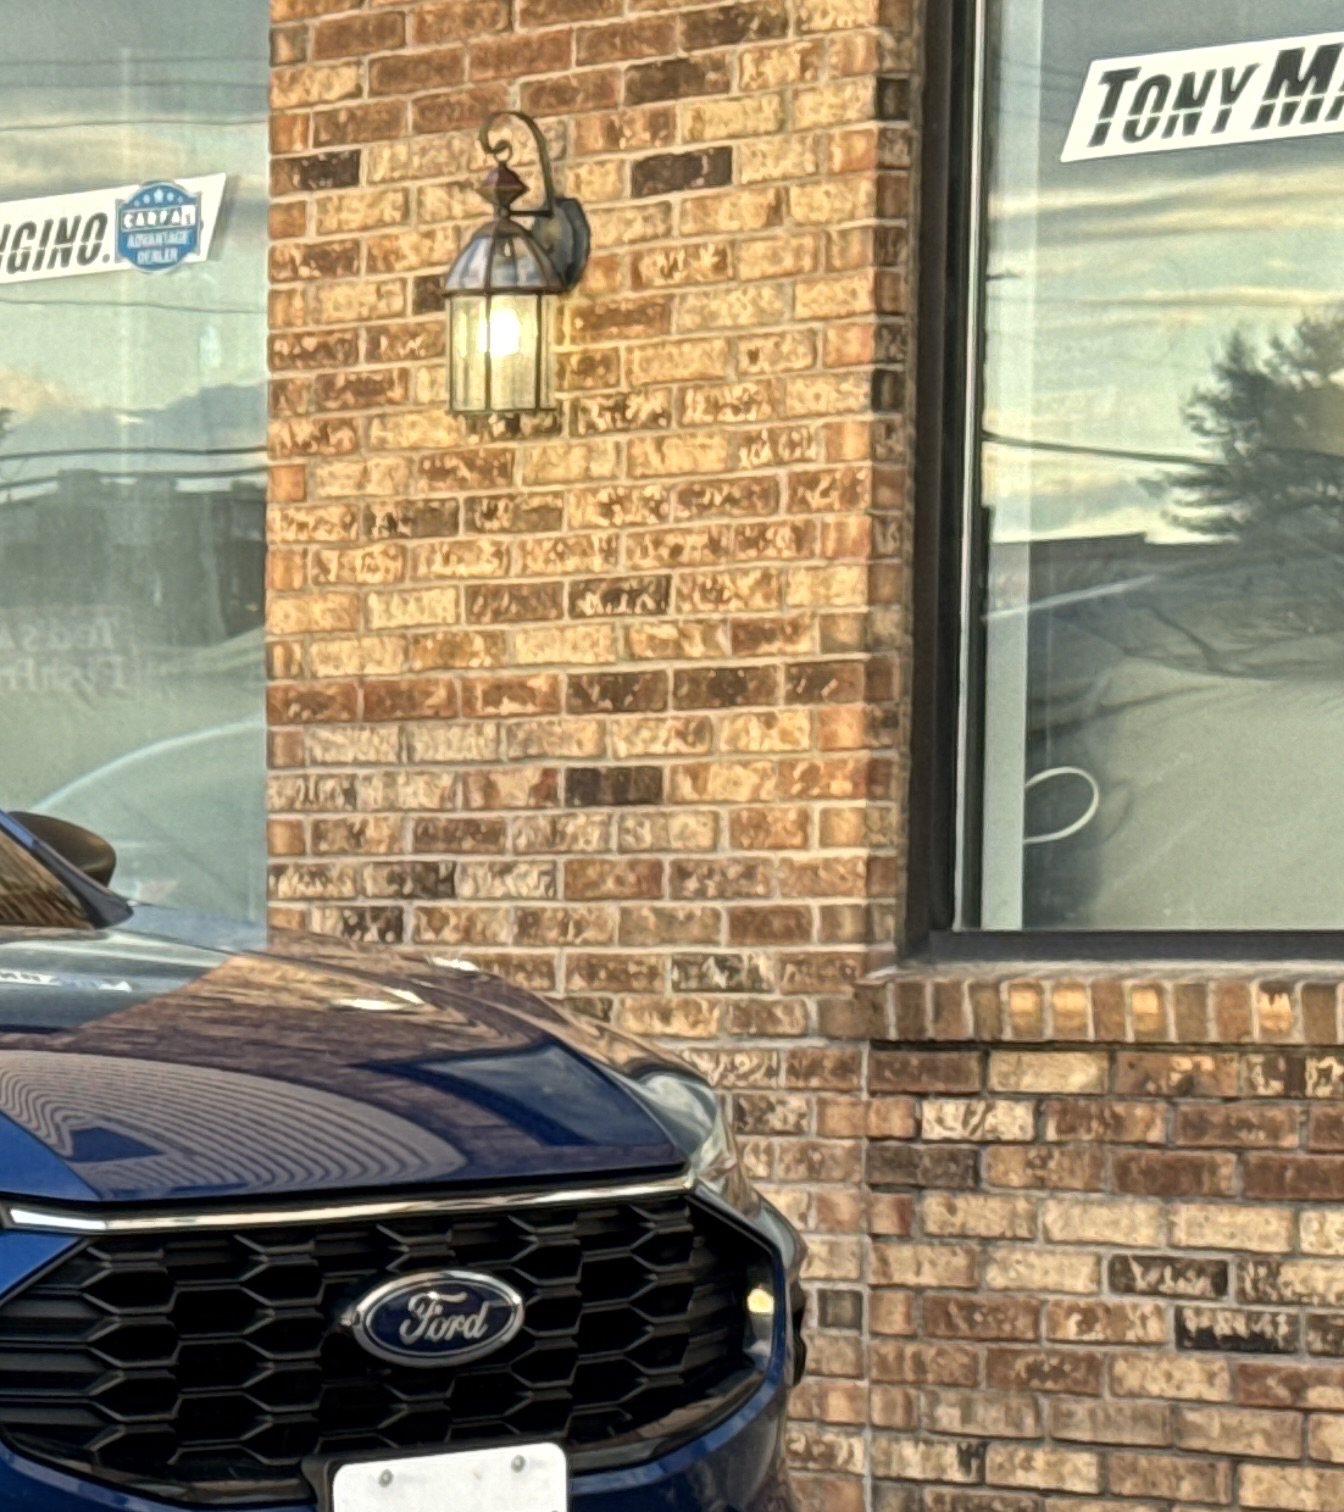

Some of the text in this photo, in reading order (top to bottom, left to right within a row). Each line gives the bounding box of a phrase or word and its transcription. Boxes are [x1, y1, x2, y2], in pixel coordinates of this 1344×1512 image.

[1086, 42, 1344, 148] TONY M
[399, 1290, 489, 1345] Ford
